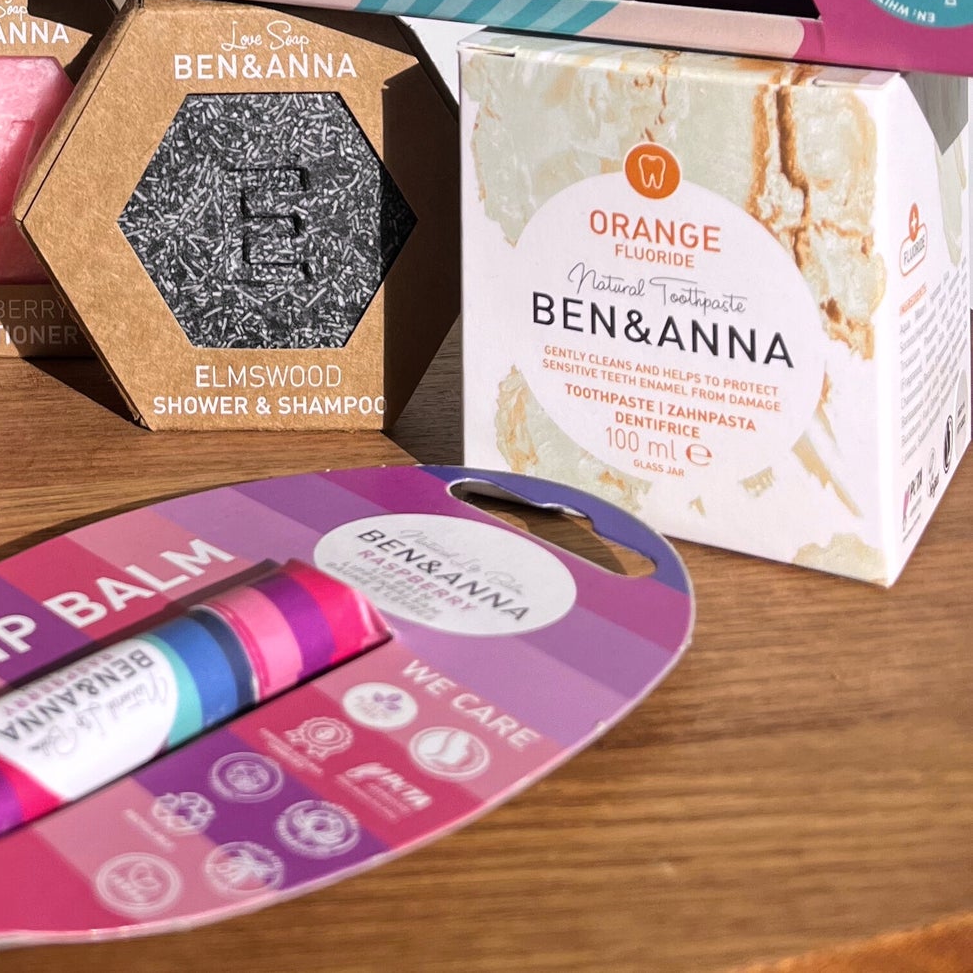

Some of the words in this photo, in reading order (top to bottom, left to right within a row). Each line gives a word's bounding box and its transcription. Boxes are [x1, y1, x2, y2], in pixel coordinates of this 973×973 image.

[221, 21, 263, 52] Love
[266, 20, 310, 53] Soap
[174, 53, 357, 81] BEN&ANNA
[590, 209, 722, 253] ORANGE
[615, 244, 695, 268] FLUORIDE
[568, 261, 645, 296] Natural
[649, 277, 747, 315] Toothpaste
[533, 291, 794, 369] BEN&ANNA
[195, 365, 342, 389] ELMSWOOD
[542, 358, 598, 379] SENSITIVE
[600, 370, 637, 386] TEETH
[639, 378, 688, 396] ENAMEL
[691, 387, 726, 403] FROM
[729, 394, 782, 412] DAMAGE
[544, 345, 586, 362] GENTLY
[588, 354, 632, 371] CLEANS
[635, 362, 660, 376] AND
[663, 368, 701, 384] HELPS
[704, 375, 720, 388] TO
[723, 379, 779, 397] PROTECT
[153, 397, 249, 416] SHOWER
[255, 396, 273, 416] &
[278, 396, 387, 416] SHAMPOO
[564, 383, 655, 412] TOOTHPASTE
[667, 404, 756, 431] ZAHNPASTA
[615, 411, 701, 439] DENTIFRICE
[605, 427, 639, 453] 100
[648, 439, 677, 461] ml
[633, 459, 665, 474] GLASS
[666, 466, 685, 477] JAR
[43, 538, 236, 629] BALM
[357, 529, 531, 621] BEN&ANNA
[358, 549, 479, 612] RASPBERRY
[401, 659, 458, 698] WE
[450, 692, 542, 750] CARE
